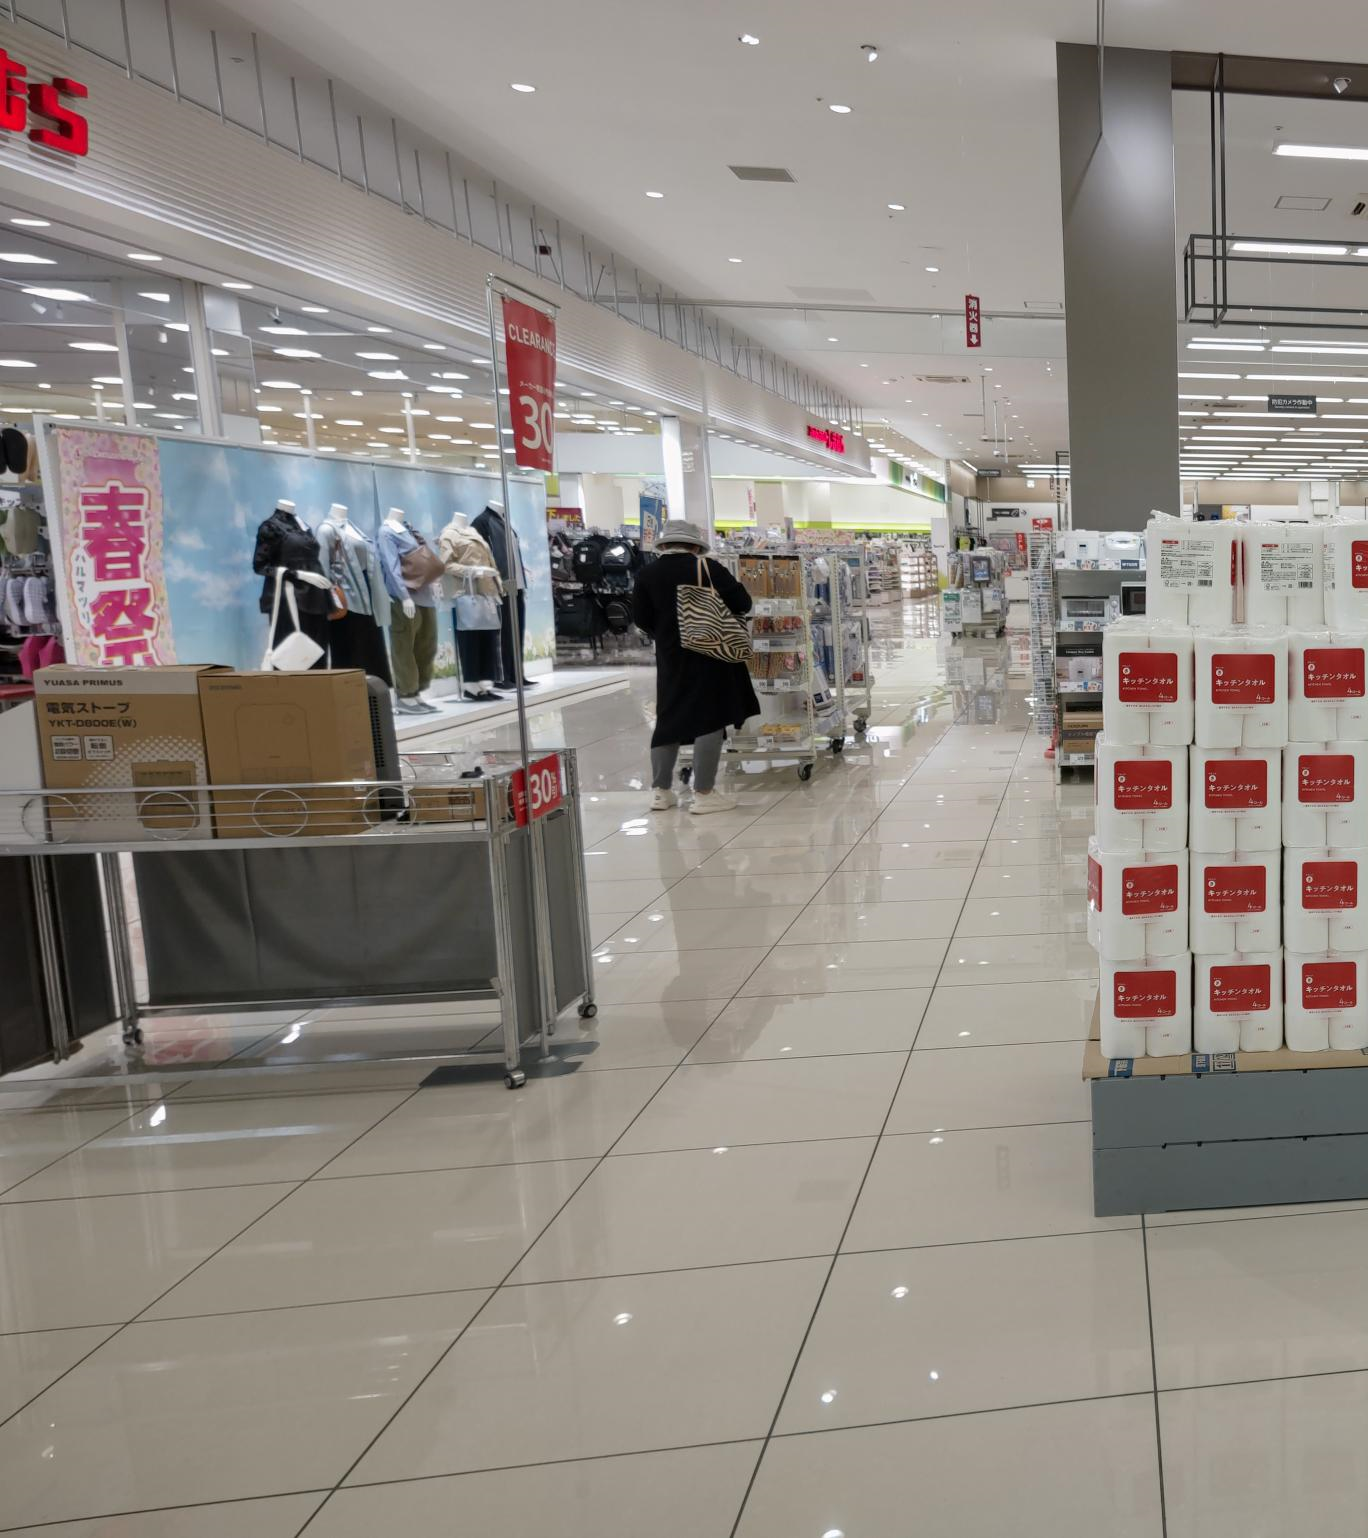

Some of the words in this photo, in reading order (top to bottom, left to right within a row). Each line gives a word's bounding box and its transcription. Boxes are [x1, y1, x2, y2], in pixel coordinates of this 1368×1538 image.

[519, 396, 553, 455] 30
[75, 553, 90, 625] ハルマツリ
[1308, 673, 1356, 681] キッチンタオル
[1122, 678, 1174, 686] キッチンタオル
[46, 702, 130, 714] 電気ストーブ
[530, 768, 551, 810] 30
[1209, 784, 1258, 792] キッチンタオル
[1126, 888, 1175, 898] キッチンタオル
[1208, 889, 1257, 897] キッチンタオル
[1214, 988, 1262, 996] キッチンタオル
[1118, 994, 1167, 1002] キッチンタオル
